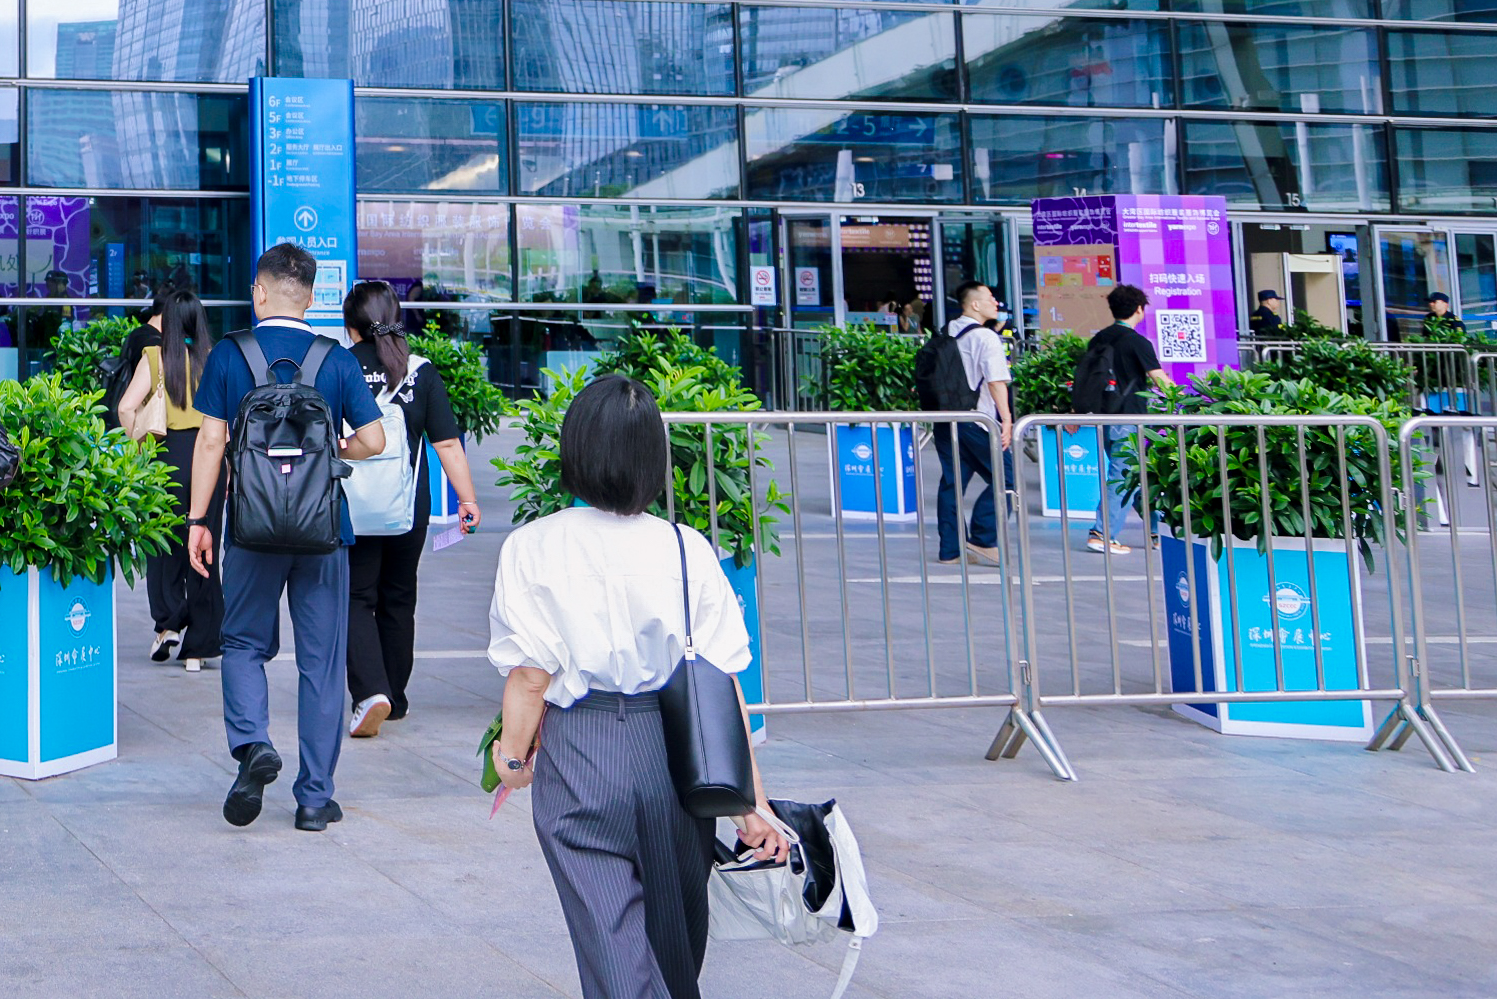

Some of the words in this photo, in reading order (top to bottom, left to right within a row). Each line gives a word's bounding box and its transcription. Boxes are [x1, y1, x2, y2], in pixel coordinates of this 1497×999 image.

[268, 95, 281, 107] 6F
[269, 111, 281, 123] 5F
[269, 127, 282, 139] 3F
[269, 143, 282, 155] 2F
[269, 159, 281, 170] 1F
[850, 183, 865, 197] 13
[1286, 192, 1301, 207] 15
[1149, 273, 1205, 284] 扫码快速入场
[1154, 286, 1202, 298] Registration
